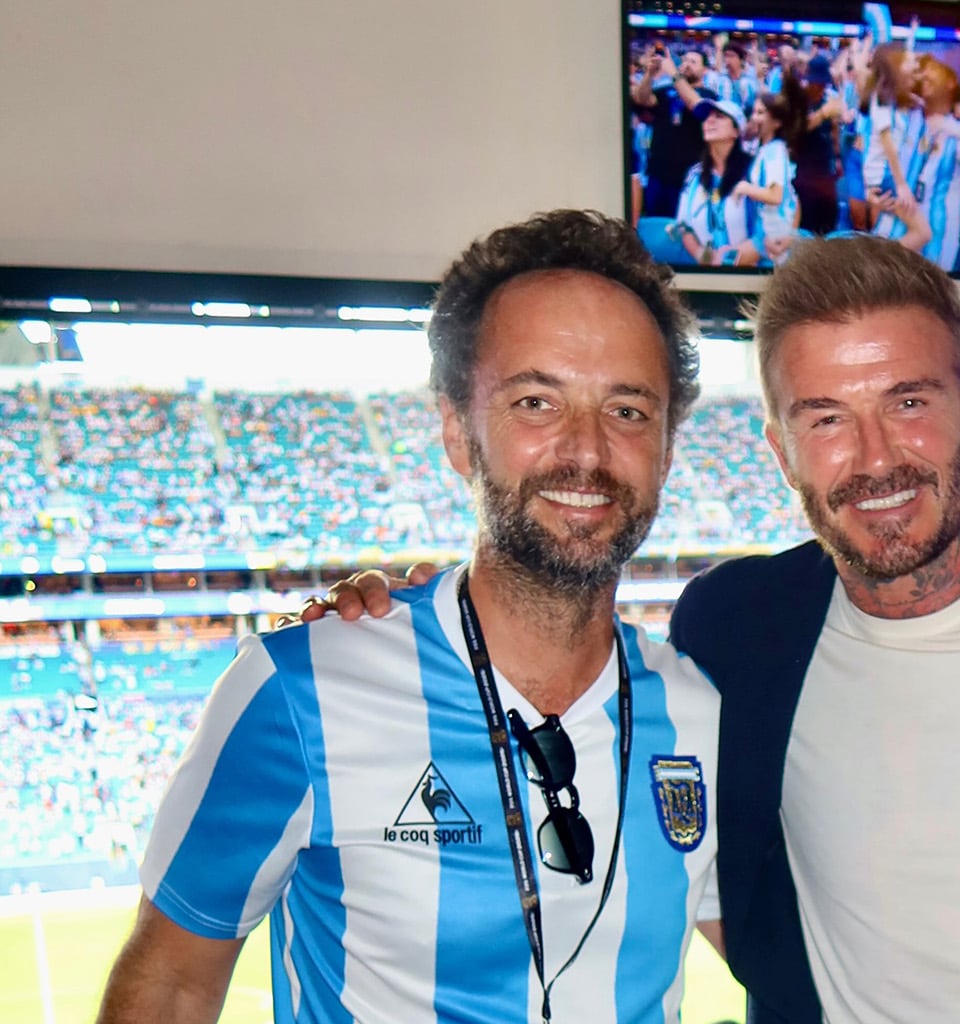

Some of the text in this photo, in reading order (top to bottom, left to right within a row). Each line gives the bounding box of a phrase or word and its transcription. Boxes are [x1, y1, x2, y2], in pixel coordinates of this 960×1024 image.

[384, 824, 483, 847] le coq sportif
